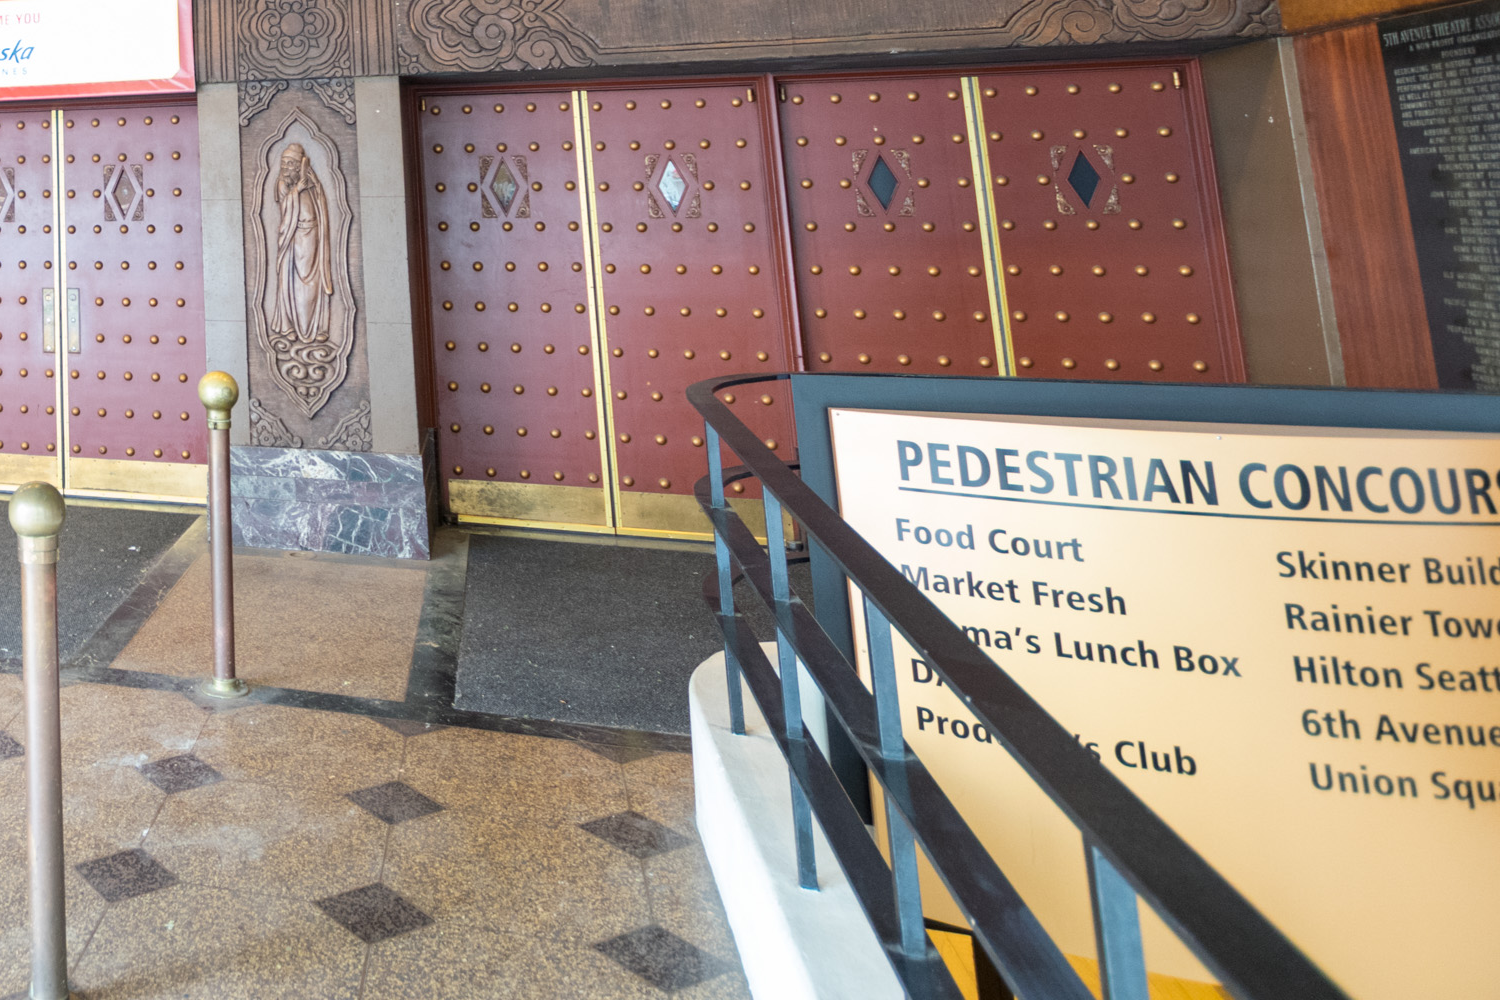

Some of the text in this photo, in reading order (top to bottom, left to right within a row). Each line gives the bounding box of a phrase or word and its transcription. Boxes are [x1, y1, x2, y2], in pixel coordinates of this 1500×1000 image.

[15, 12, 41, 25] YOU
[1383, 32, 1400, 47] 5TH
[1400, 25, 1433, 43] AVENUE
[1432, 18, 1472, 37] THEATRE
[896, 439, 1500, 515] PEDESTRIAN CONCOUR
[895, 517, 1084, 562] Food Court
[1276, 550, 1411, 583] Skinner
[901, 563, 1127, 616] Market Fresh
[1284, 603, 1500, 639] Rainier Tow
[1054, 632, 1160, 669] Lunch
[1173, 645, 1242, 678] Box
[1293, 655, 1403, 689] Hilton
[1301, 709, 1500, 747] 6th Avenue
[1114, 740, 1198, 776] Club
[1308, 762, 1500, 810] Union Squ
